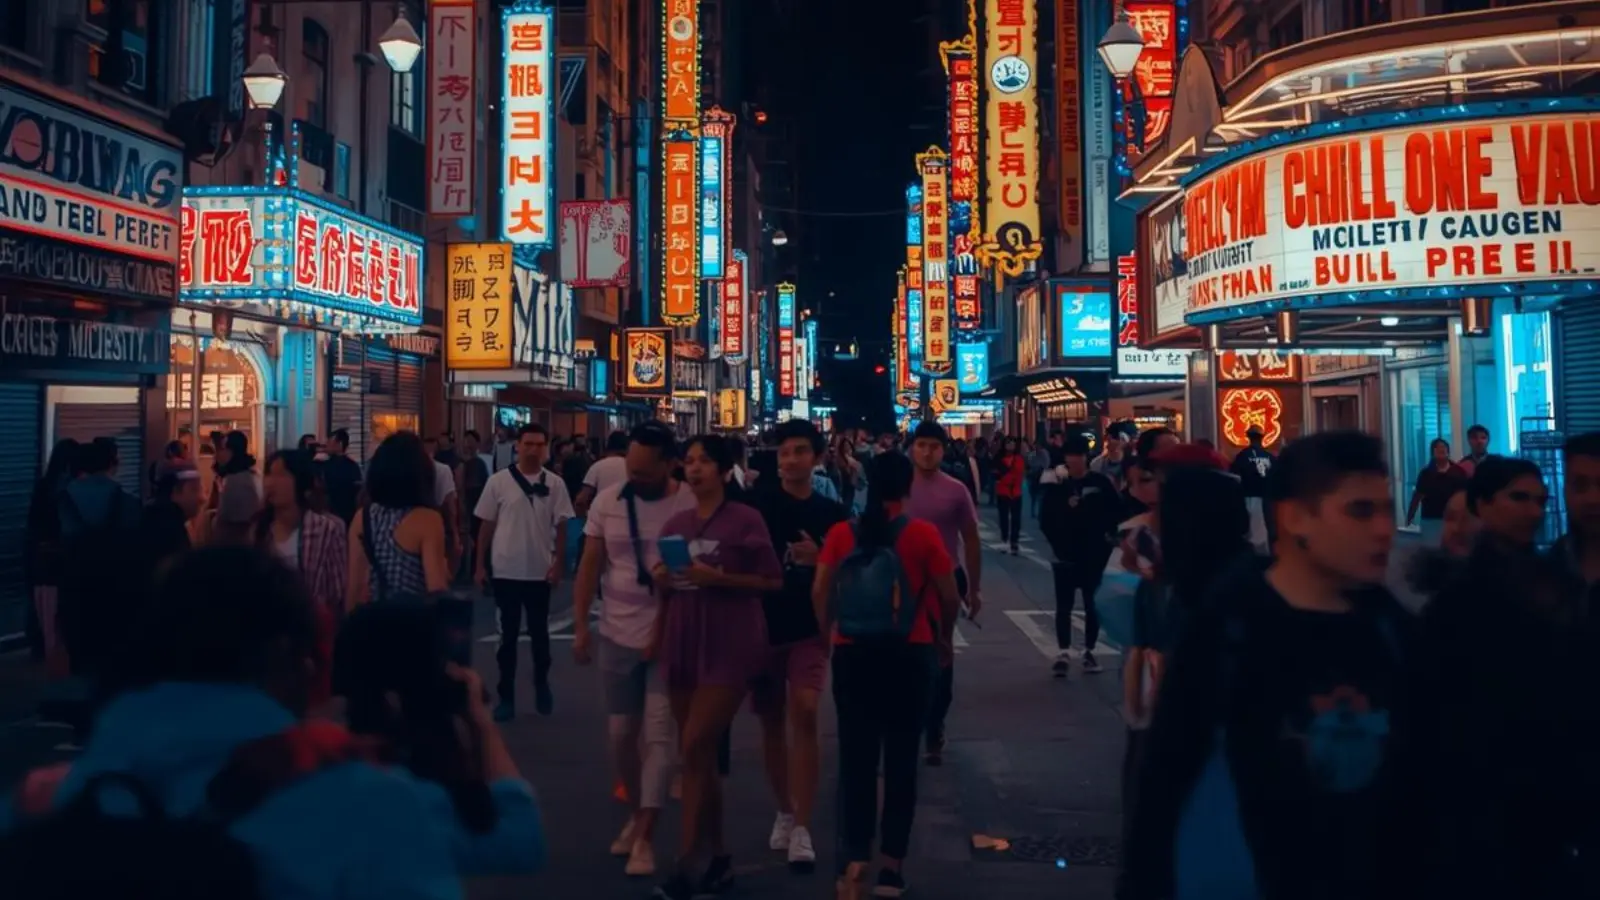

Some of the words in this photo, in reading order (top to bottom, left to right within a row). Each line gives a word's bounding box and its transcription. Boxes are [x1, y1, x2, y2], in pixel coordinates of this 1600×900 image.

[1405, 126, 1498, 215] ONE
[54, 199, 107, 237] TEBL
[1441, 210, 1562, 239] CAUGEN
